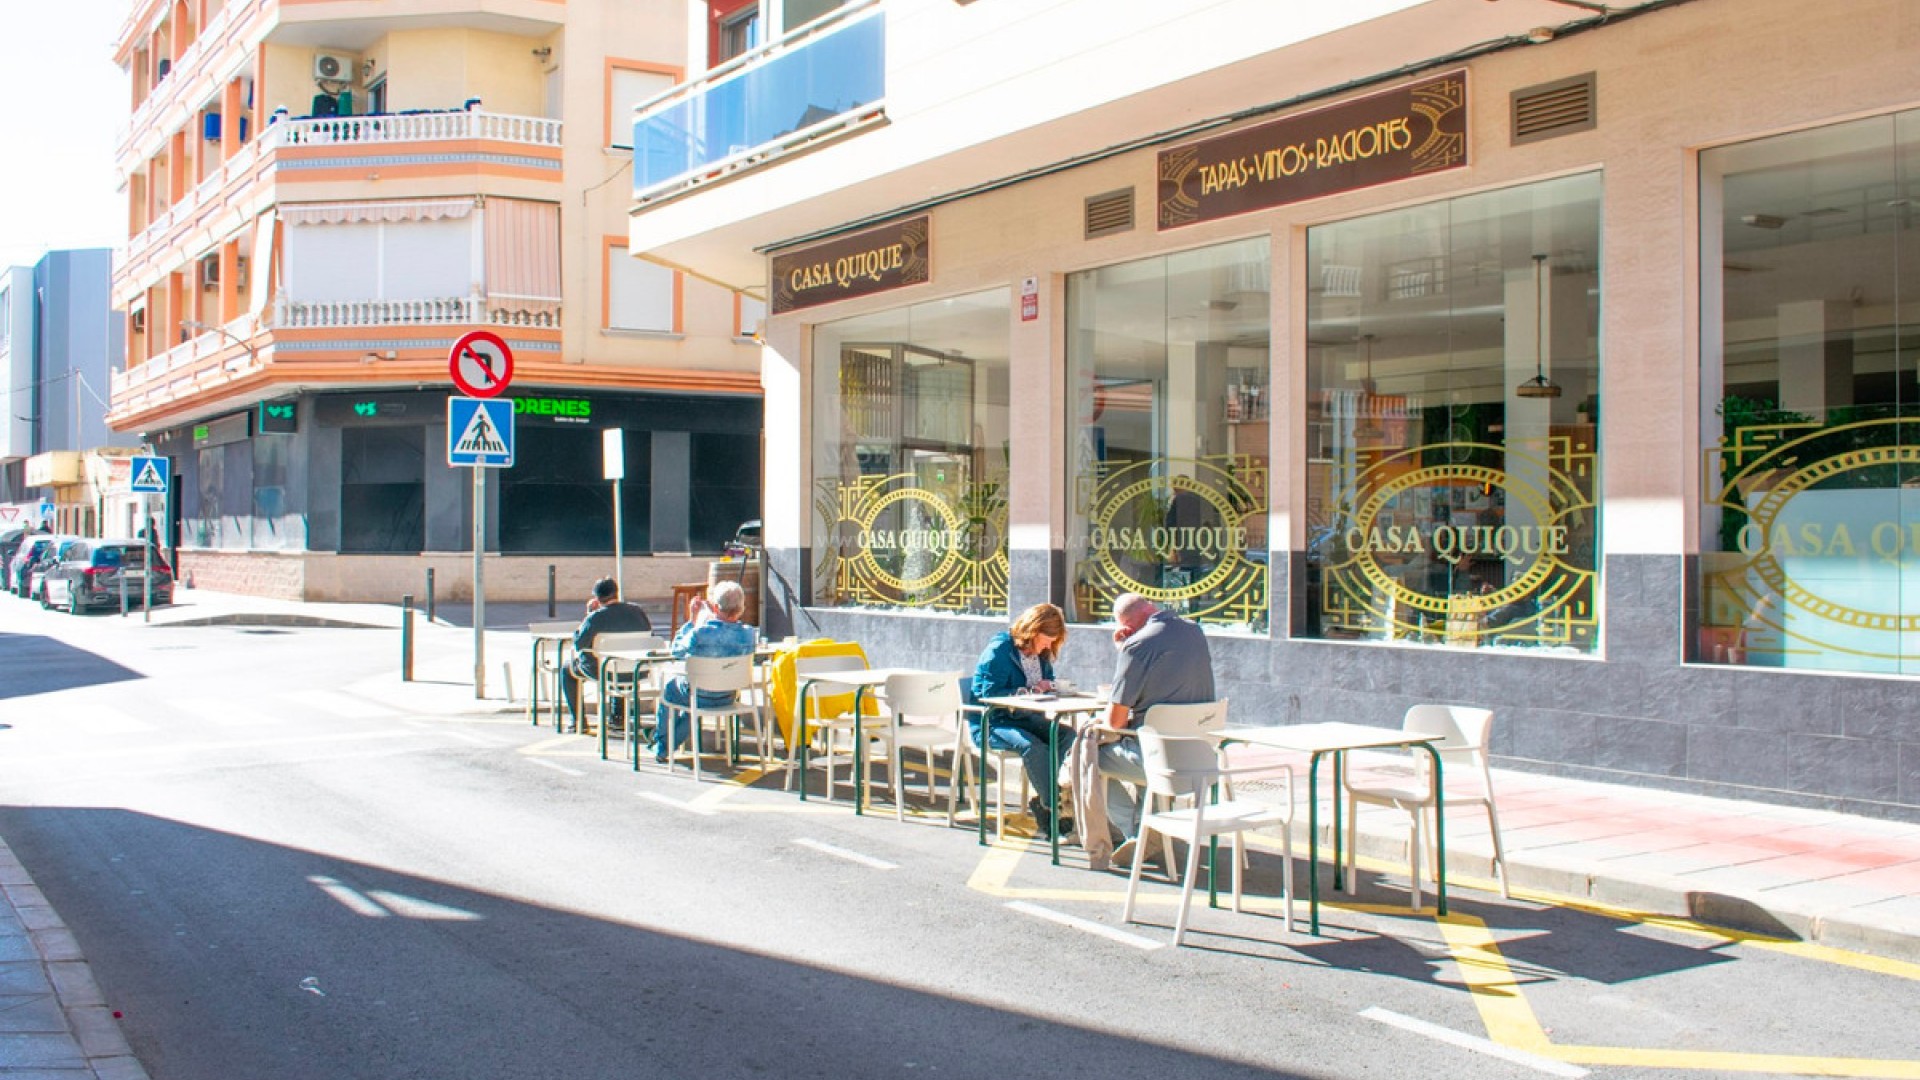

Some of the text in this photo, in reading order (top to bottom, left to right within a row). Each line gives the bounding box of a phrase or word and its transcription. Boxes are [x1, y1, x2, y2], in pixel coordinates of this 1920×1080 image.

[791, 243, 903, 292] CASA QUIQUE
[857, 529, 897, 549] CASA
[900, 529, 964, 557] QUIQUE
[1091, 526, 1147, 551] CASA
[1152, 526, 1247, 559] QUIQUE
[1345, 524, 1569, 564] CASA QUIQUE
[1737, 522, 1854, 556] CASA
